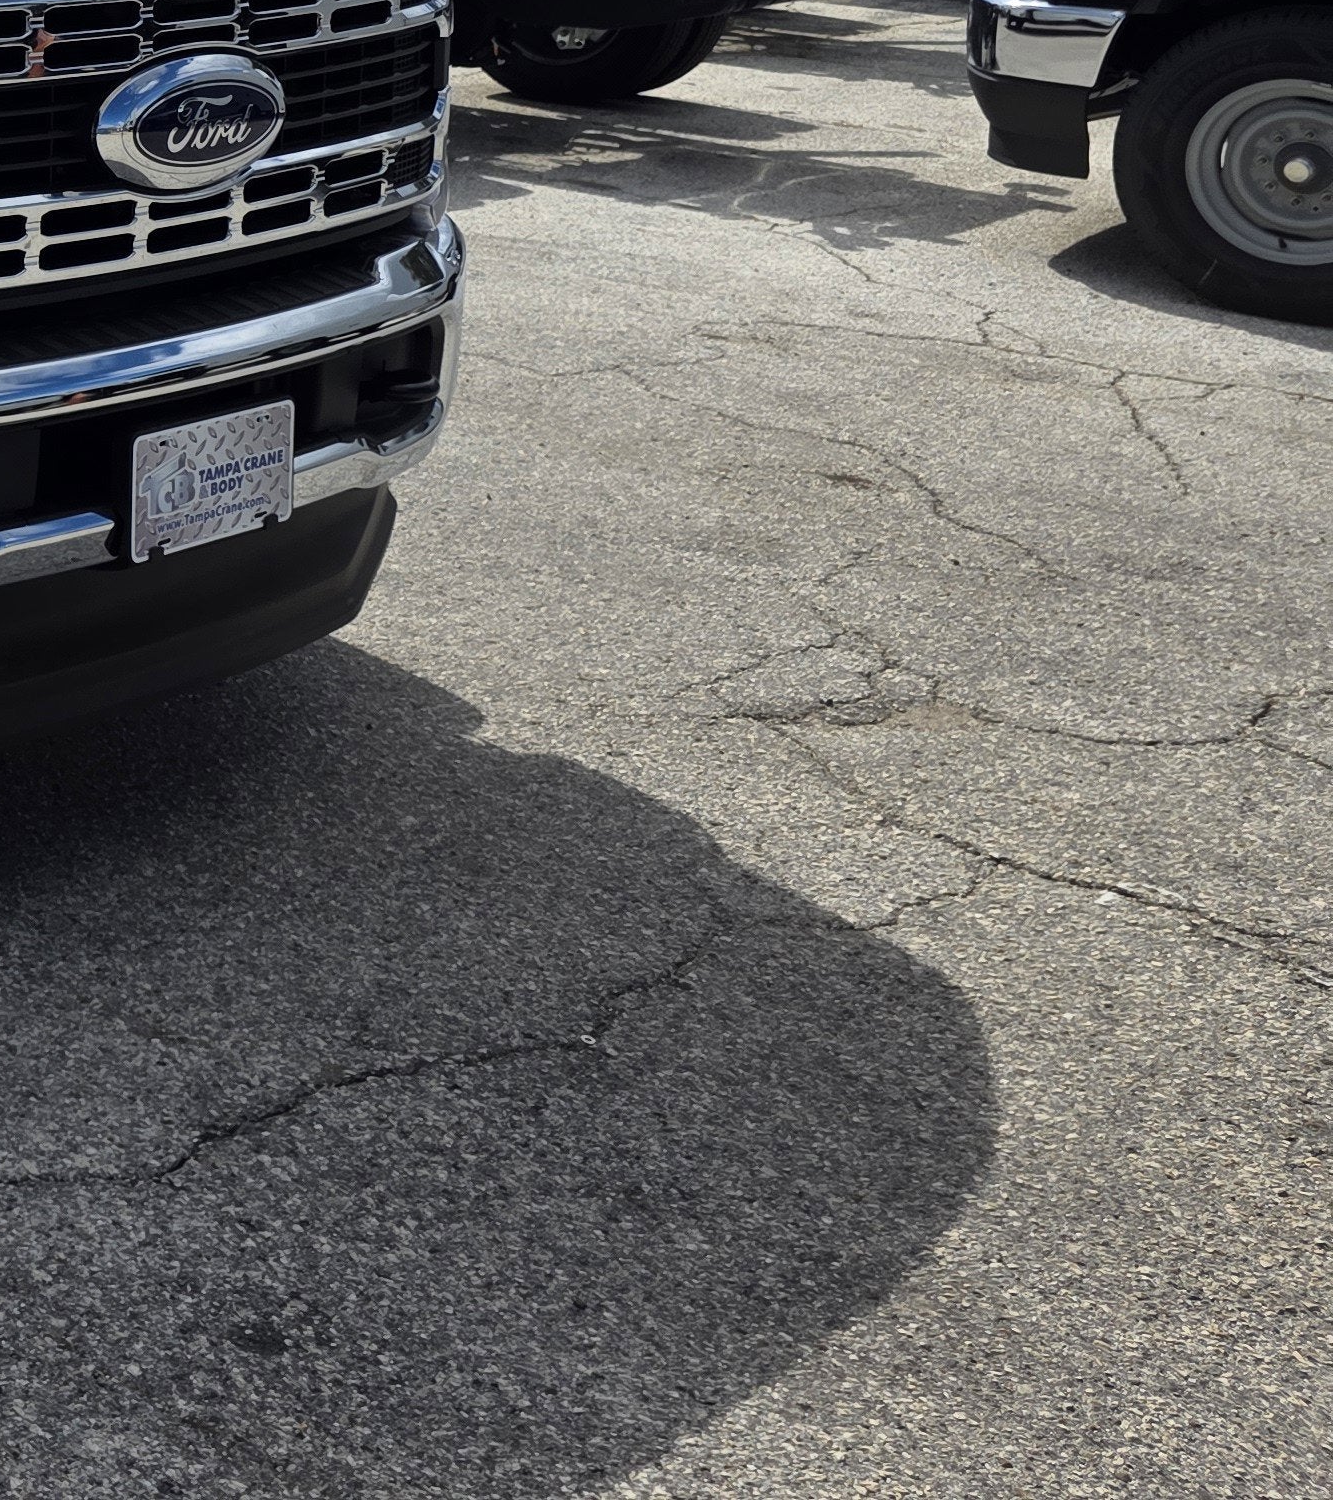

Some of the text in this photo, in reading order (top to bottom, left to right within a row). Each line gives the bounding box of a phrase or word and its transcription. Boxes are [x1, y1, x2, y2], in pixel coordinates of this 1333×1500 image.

[167, 94, 253, 153] Ford
[198, 449, 284, 483] TAMPA CRANE
[198, 474, 244, 499] & BODY
[157, 496, 266, 533] www.TampaCrane.com
